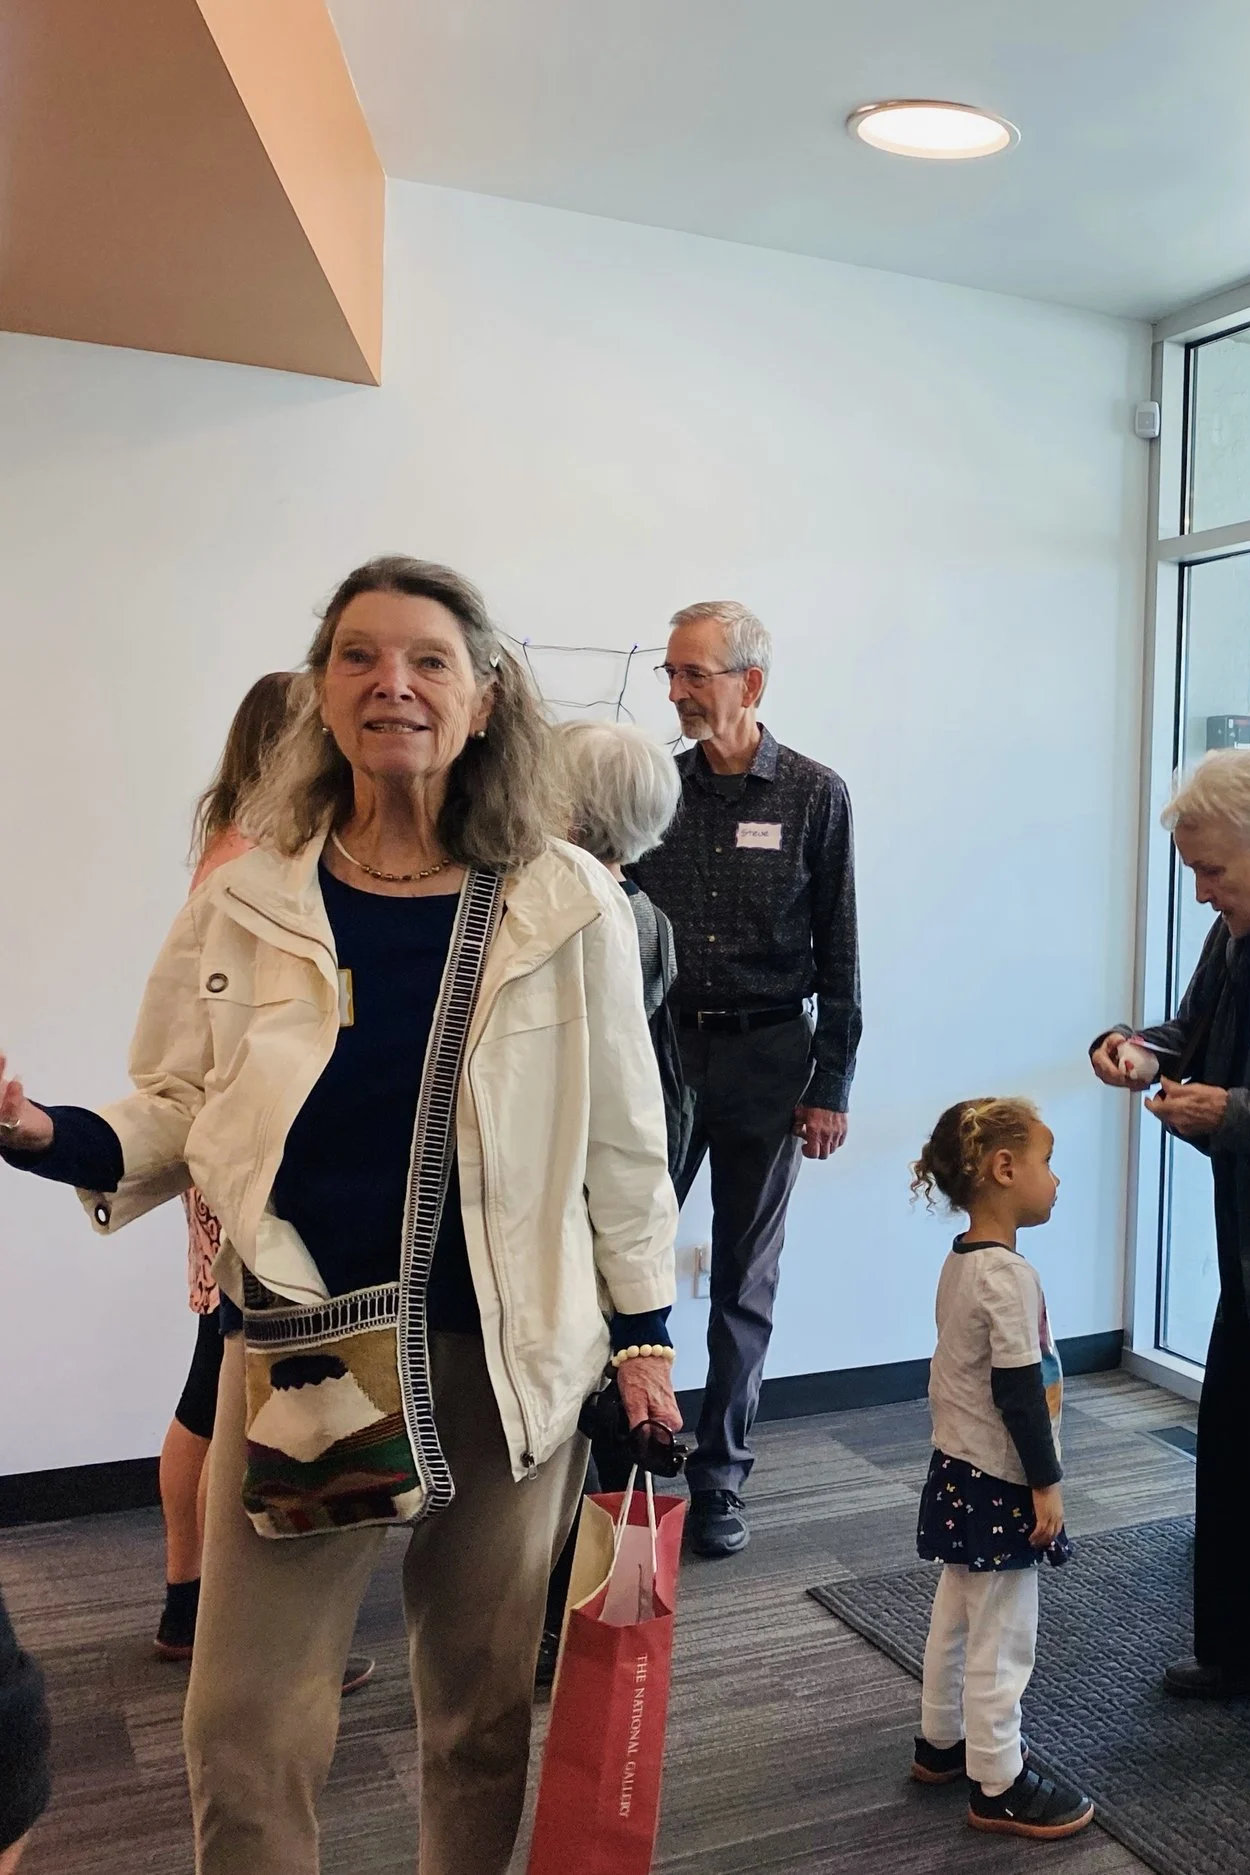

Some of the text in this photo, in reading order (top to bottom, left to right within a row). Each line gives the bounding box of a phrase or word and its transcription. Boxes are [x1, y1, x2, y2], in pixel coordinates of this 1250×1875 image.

[618, 1653, 648, 1818] THE NATIONAL GALLERY
